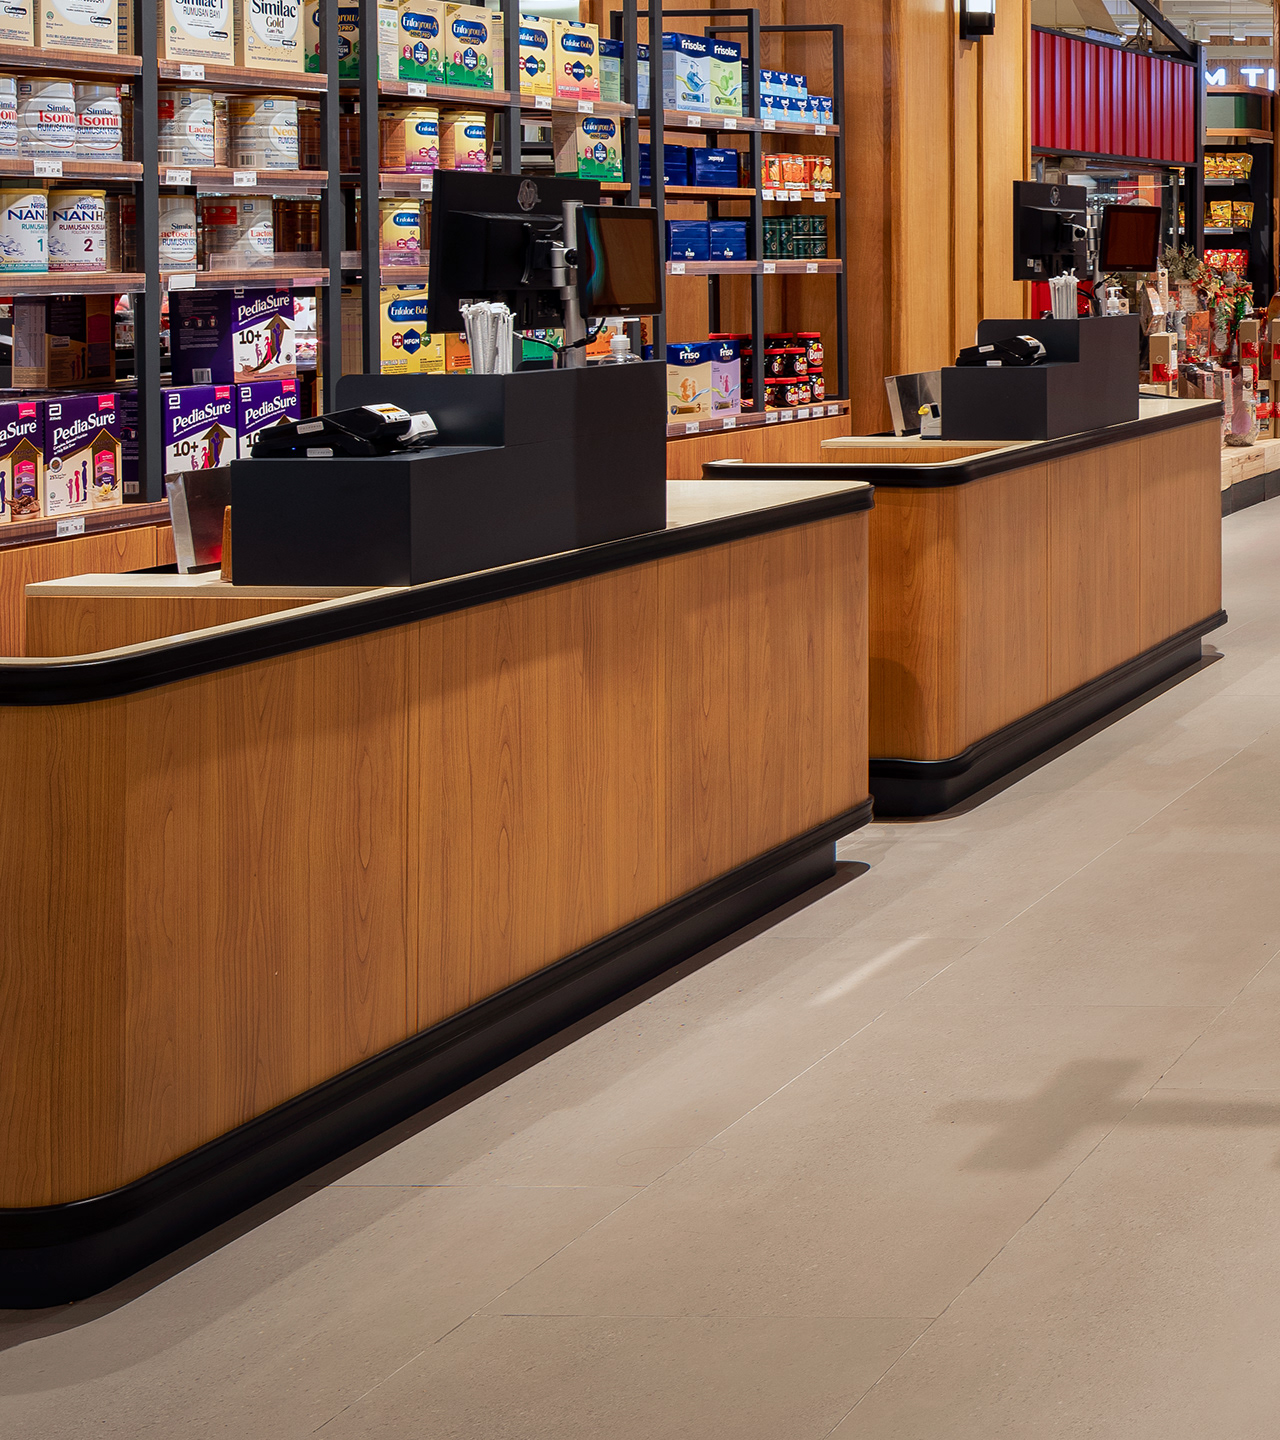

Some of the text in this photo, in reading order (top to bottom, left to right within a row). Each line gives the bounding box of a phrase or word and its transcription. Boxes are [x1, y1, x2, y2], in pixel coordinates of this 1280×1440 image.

[183, 6, 220, 19] RUMUSAN BAYI
[266, 16, 284, 28] Gold
[682, 40, 706, 52] Frisolac
[714, 45, 737, 57] Frisolac
[438, 62, 443, 73] 4
[486, 67, 492, 78] 4
[615, 159, 621, 169] 4
[8, 210, 44, 220] NAN
[53, 210, 94, 221] NAN
[37, 239, 43, 252] 1
[84, 239, 93, 252] 2
[238, 296, 290, 320] PediaSure
[415, 305, 428, 314] Bab
[238, 330, 262, 345] 10+
[679, 350, 700, 359] Friso
[720, 348, 733, 357] Friso
[245, 395, 297, 424] PediaSure
[696, 404, 701, 413] 3
[172, 402, 232, 433] PediaSure
[0, 420, 37, 441] aSure
[53, 412, 116, 445] PediaSure
[173, 441, 198, 457] 10+
